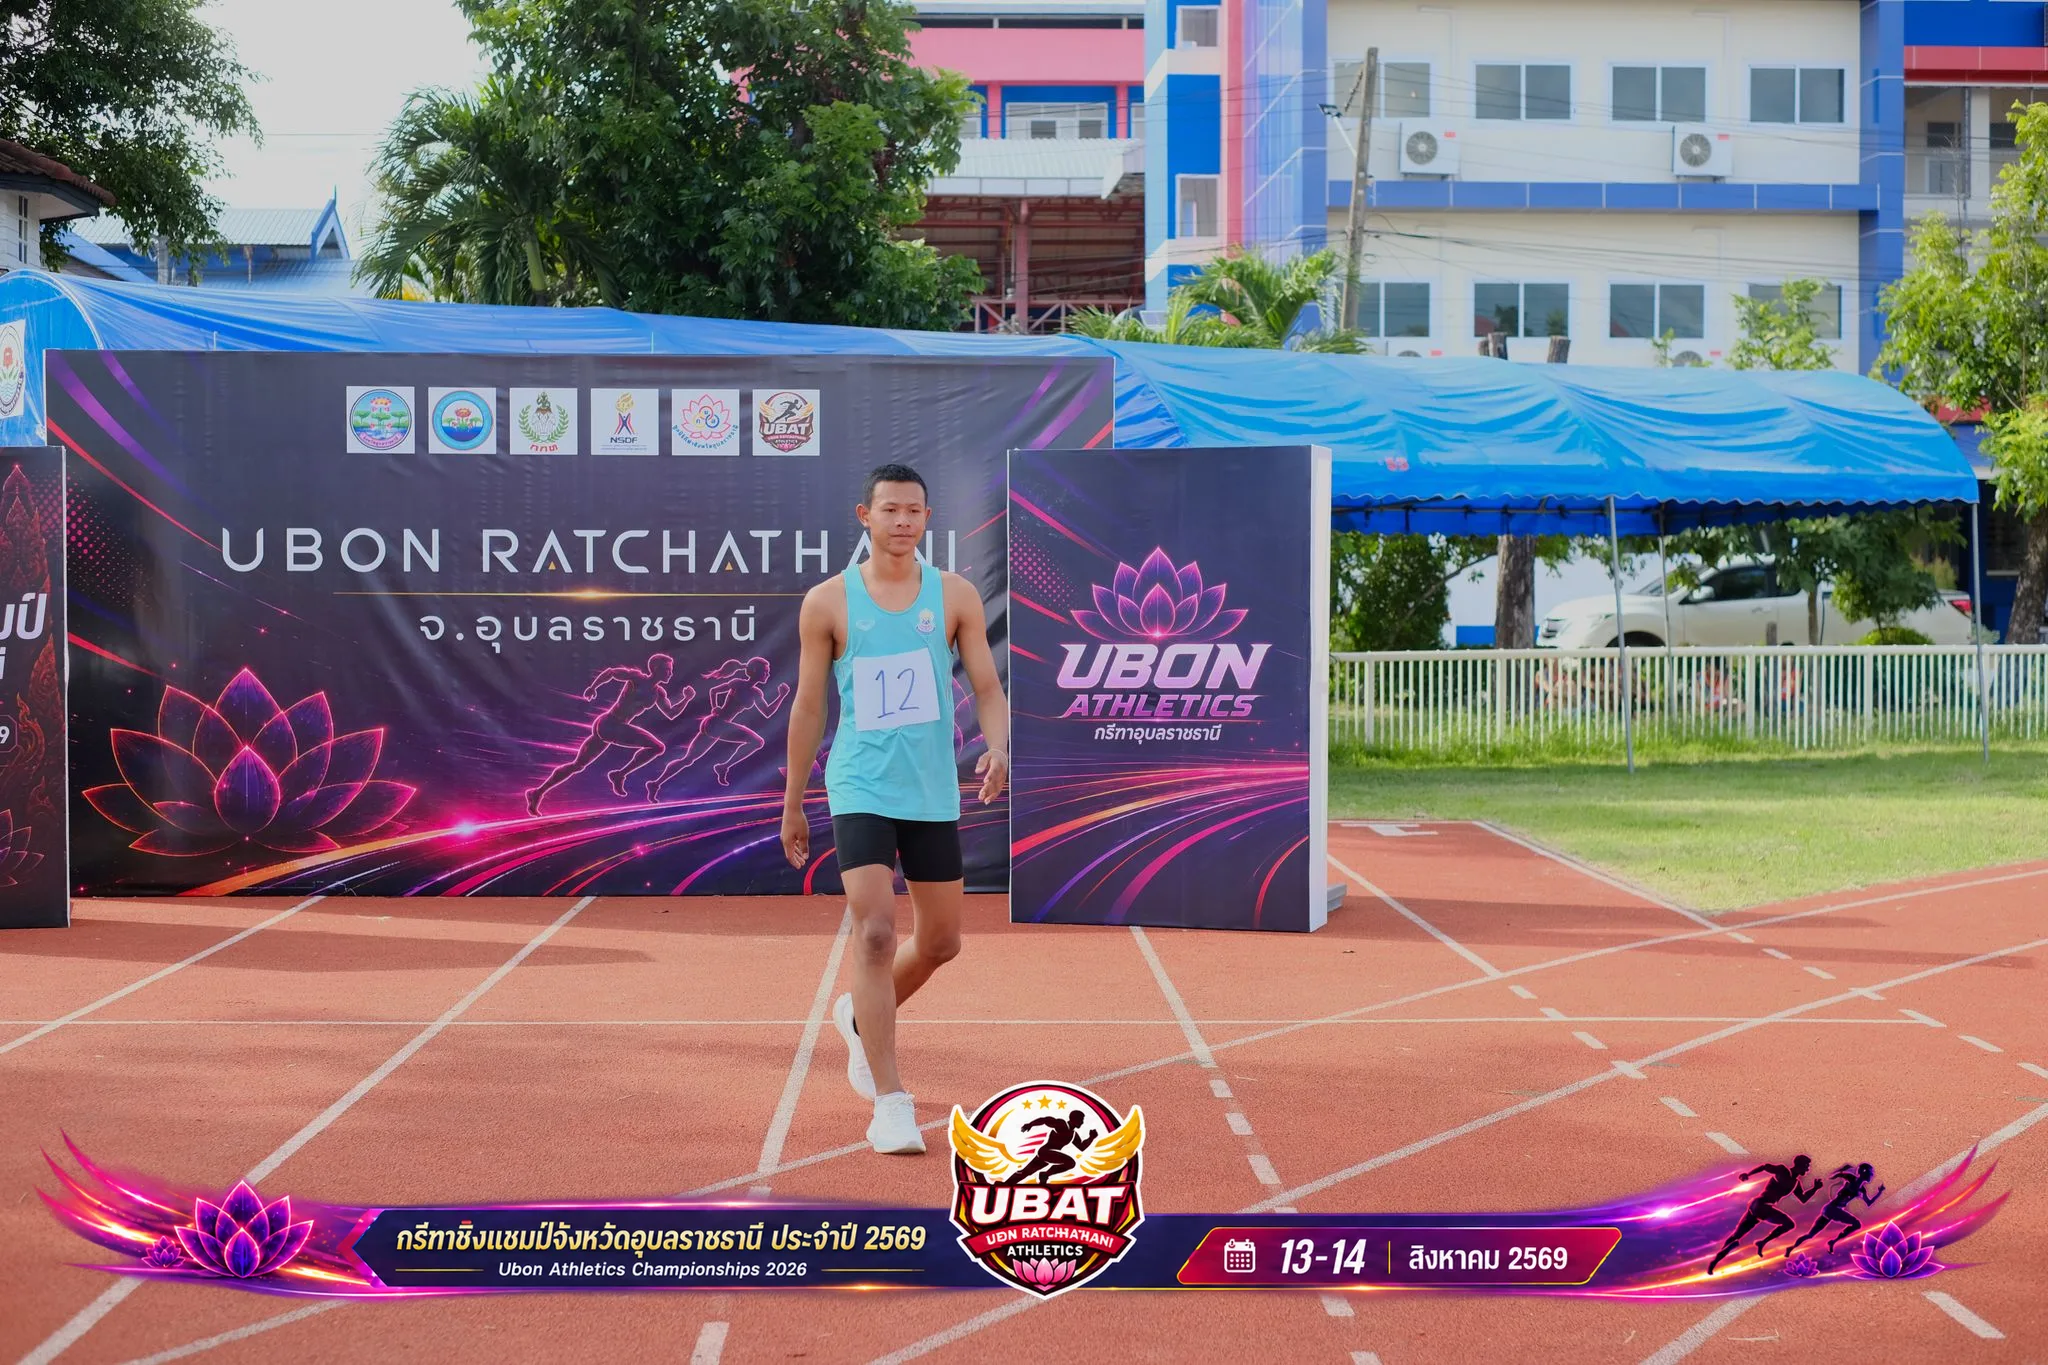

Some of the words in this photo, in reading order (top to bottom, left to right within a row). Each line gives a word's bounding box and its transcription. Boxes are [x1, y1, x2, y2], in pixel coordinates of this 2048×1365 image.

[610, 436, 638, 444] NSDF
[763, 423, 810, 436] UBAT
[222, 528, 440, 573] UBON
[420, 606, 755, 653] จ.อุบลราชธานี
[1056, 643, 1273, 690] UBON
[875, 668, 920, 719] 12
[1060, 694, 1262, 718] ATHLETICS
